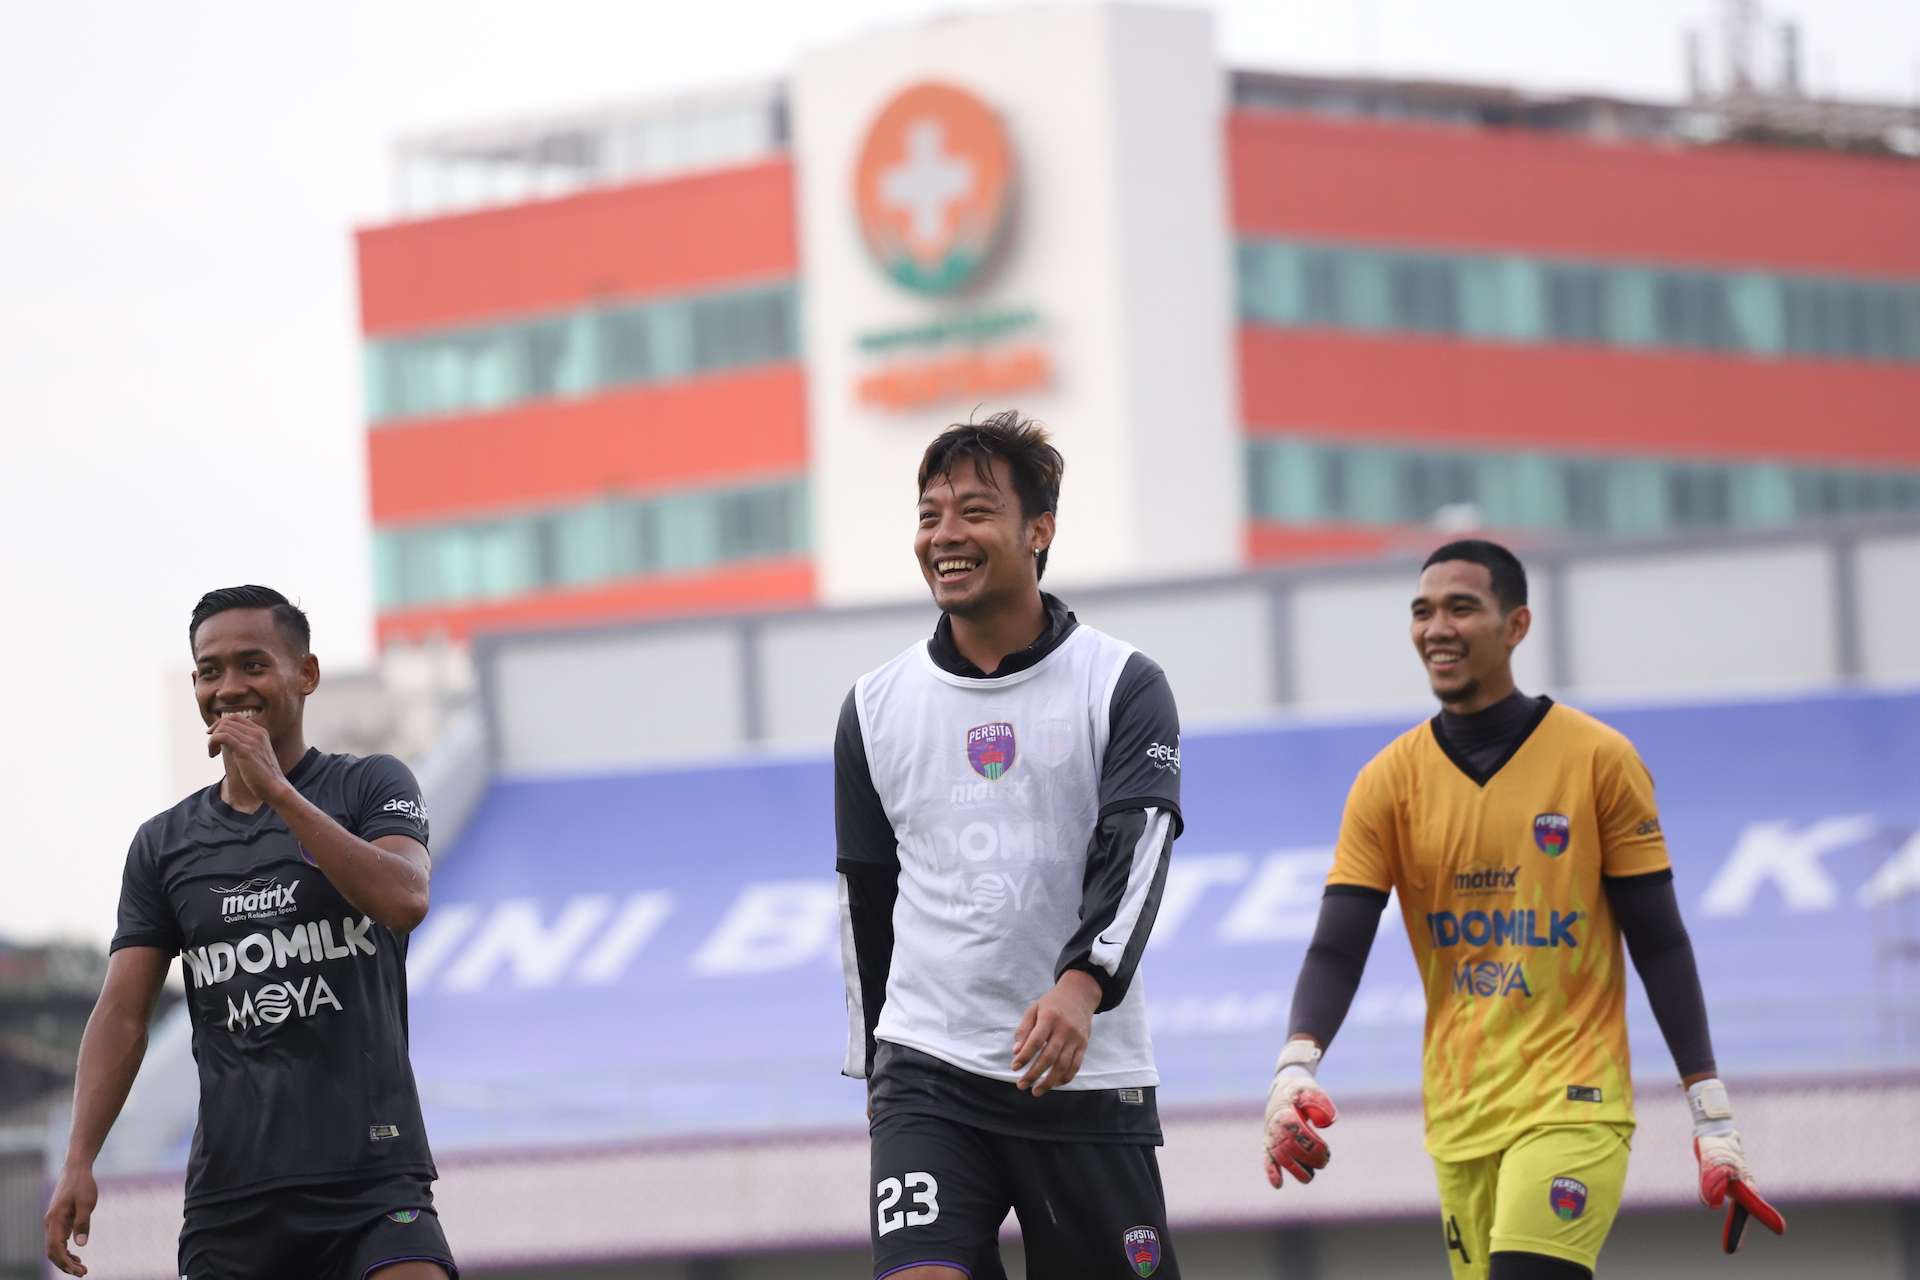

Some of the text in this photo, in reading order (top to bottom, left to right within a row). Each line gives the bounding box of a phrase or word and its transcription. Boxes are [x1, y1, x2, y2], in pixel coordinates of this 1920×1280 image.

[968, 725, 1013, 744] PERSITA
[1455, 866, 1521, 889] matrix
[221, 880, 300, 915] matrix
[226, 974, 343, 1032] MOYA
[876, 1171, 940, 1238] 23
[1125, 1229, 1157, 1245] PERSITA
